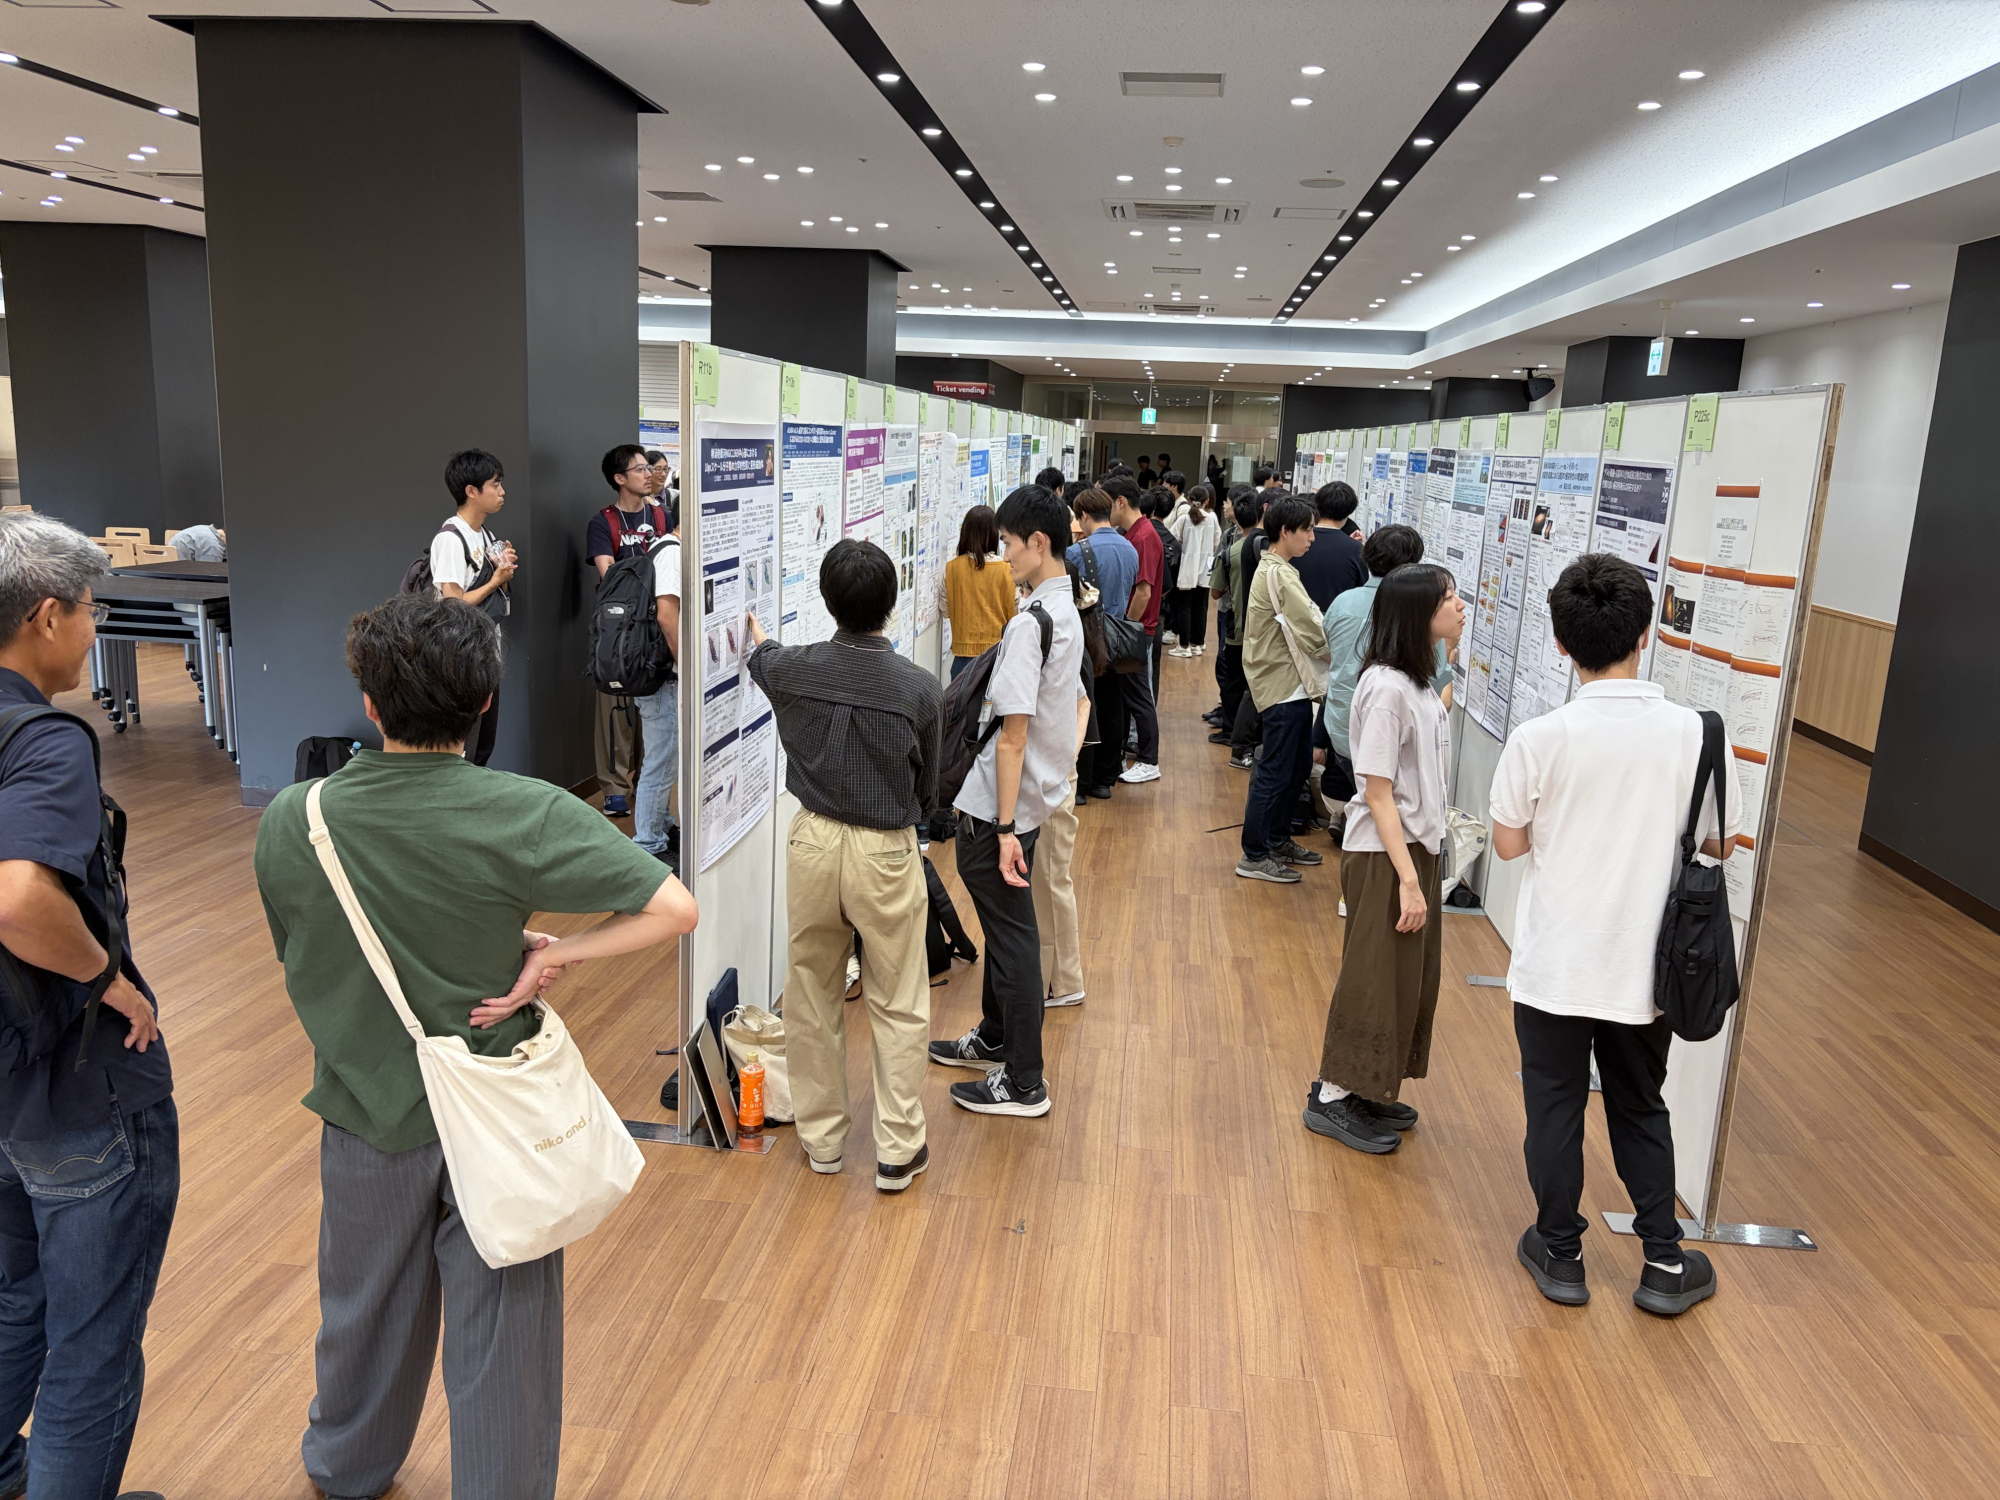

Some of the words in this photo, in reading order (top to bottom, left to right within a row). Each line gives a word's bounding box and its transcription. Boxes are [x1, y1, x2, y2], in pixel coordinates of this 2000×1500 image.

[698, 360, 713, 376] R11b
[936, 385, 957, 393] Ticket
[958, 386, 985, 395] vending
[1694, 409, 1711, 423] P225c
[990, 1084, 1012, 1102] N
[1324, 1108, 1350, 1131] HOKA
[533, 1135, 564, 1153] niko
[565, 1115, 587, 1139] and
